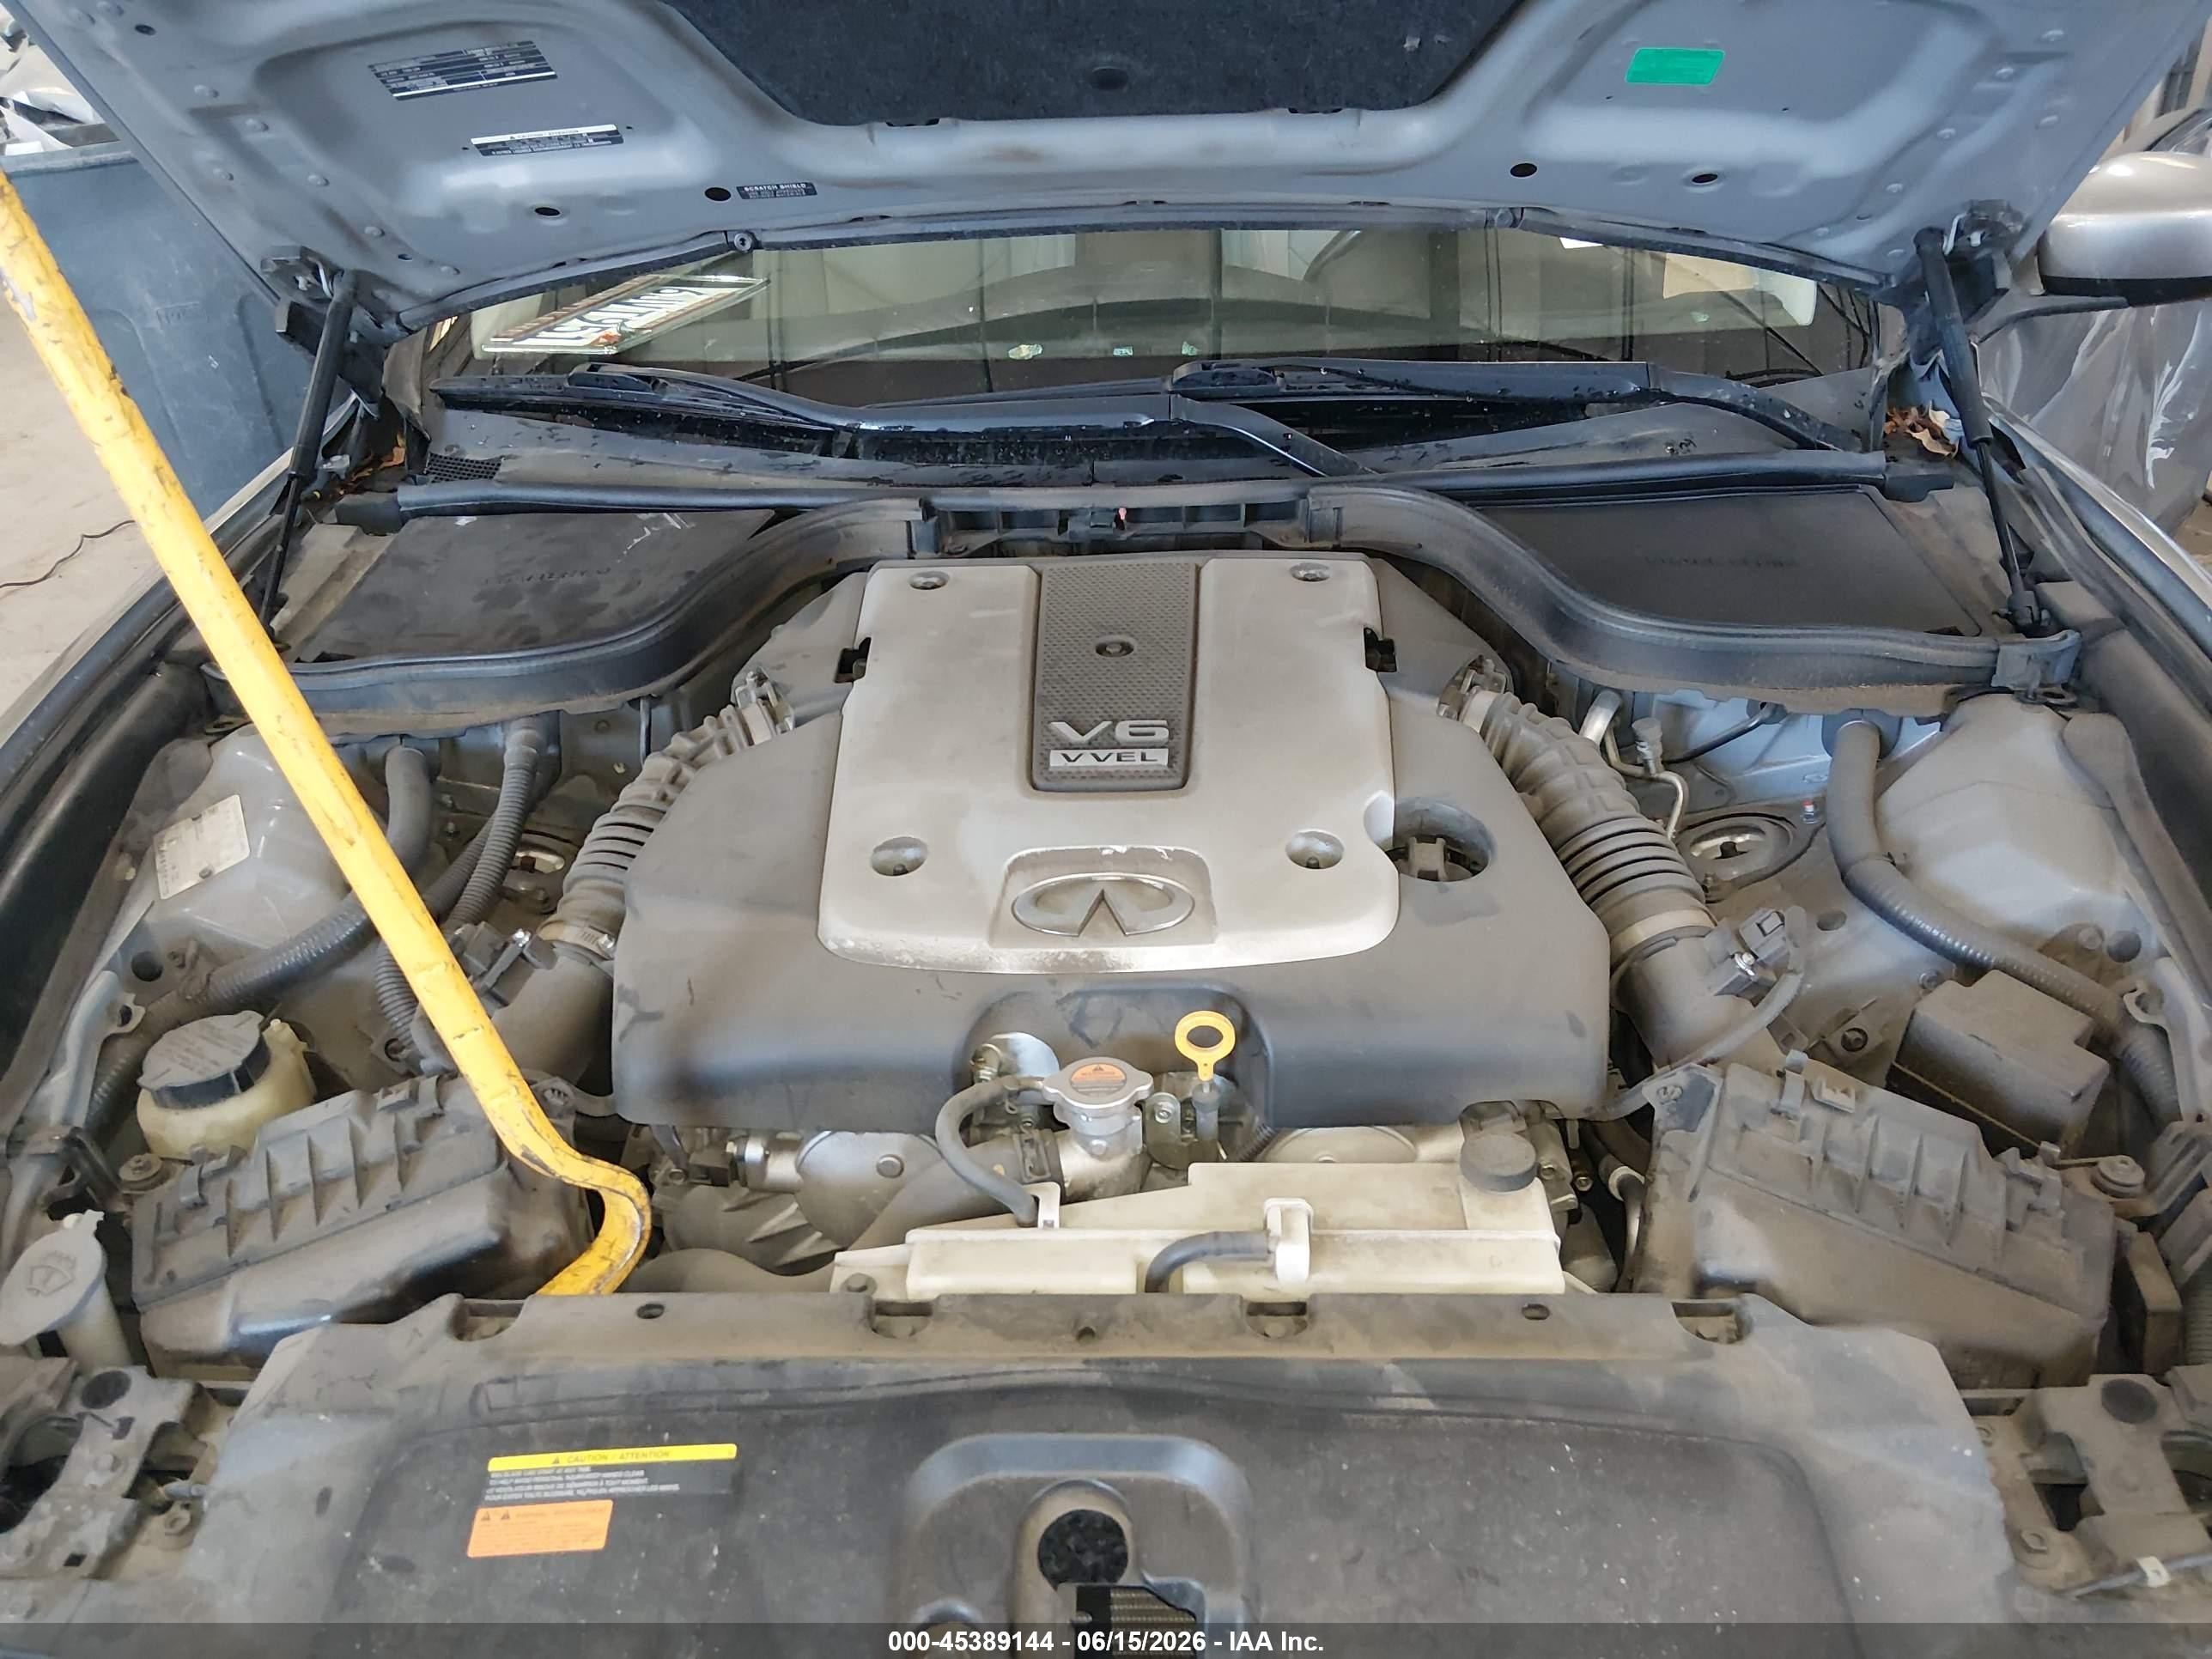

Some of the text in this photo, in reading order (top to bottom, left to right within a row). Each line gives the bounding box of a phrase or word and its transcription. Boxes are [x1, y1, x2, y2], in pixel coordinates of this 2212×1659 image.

[525, 287, 704, 341] 6JVT951
[1049, 720, 1170, 745] V6
[1061, 751, 1158, 763] VVEL
[567, 1455, 609, 1464] CAUTION
[618, 1450, 671, 1461] ATTENTION
